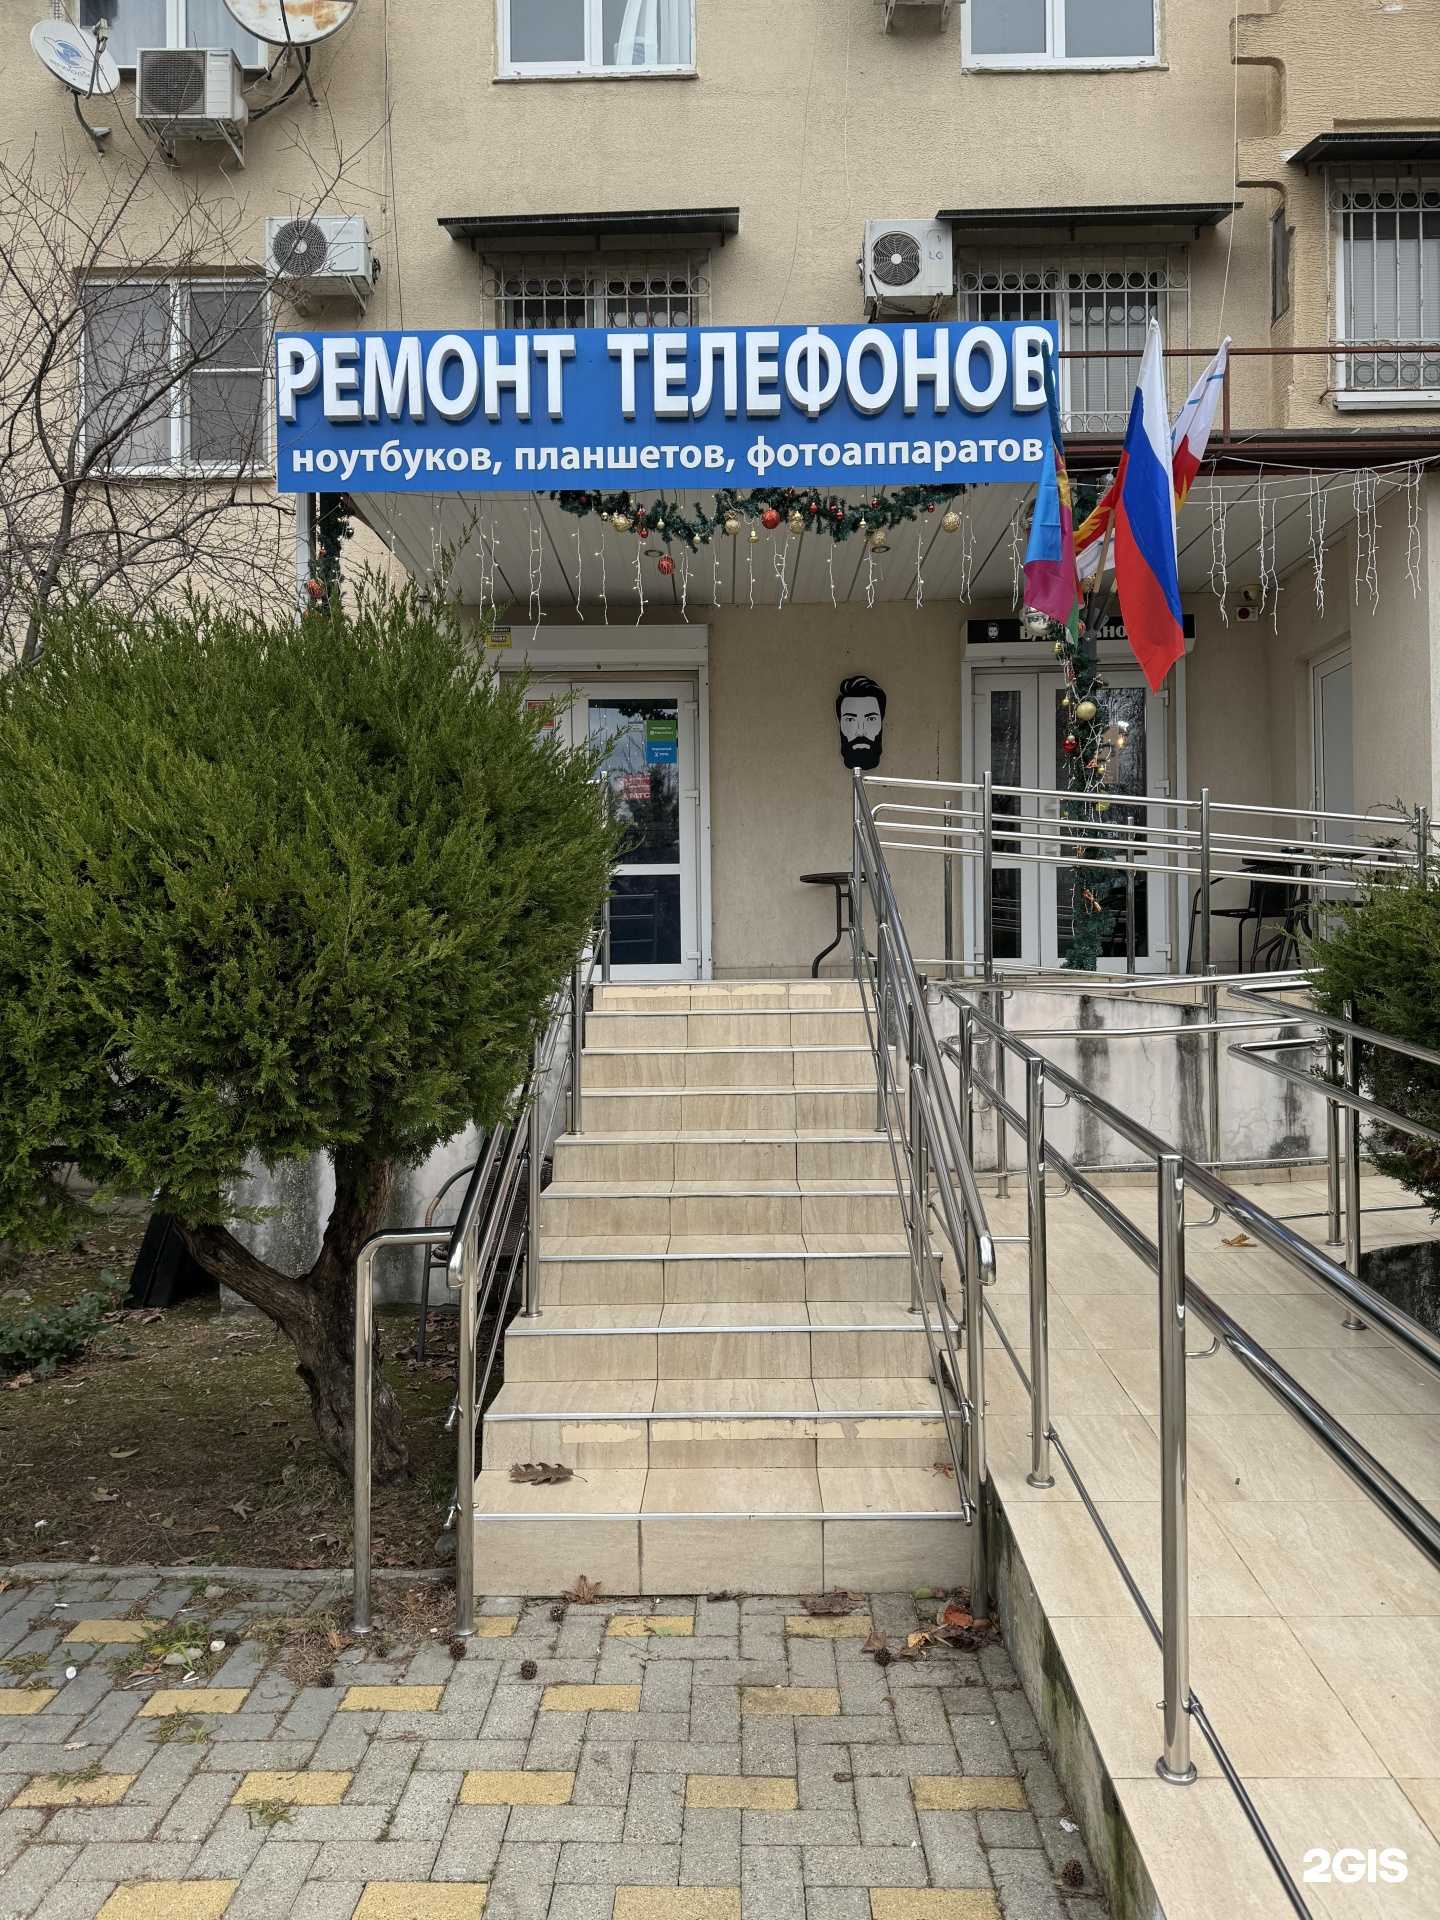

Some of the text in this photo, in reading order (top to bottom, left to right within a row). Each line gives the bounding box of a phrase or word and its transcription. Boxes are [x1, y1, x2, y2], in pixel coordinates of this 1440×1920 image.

[277, 326, 1056, 423] РЕМОНТ ТЕЛЕФОНОВ
[292, 435, 1044, 481] ноутбуков, планшетов, фотоаппаратов
